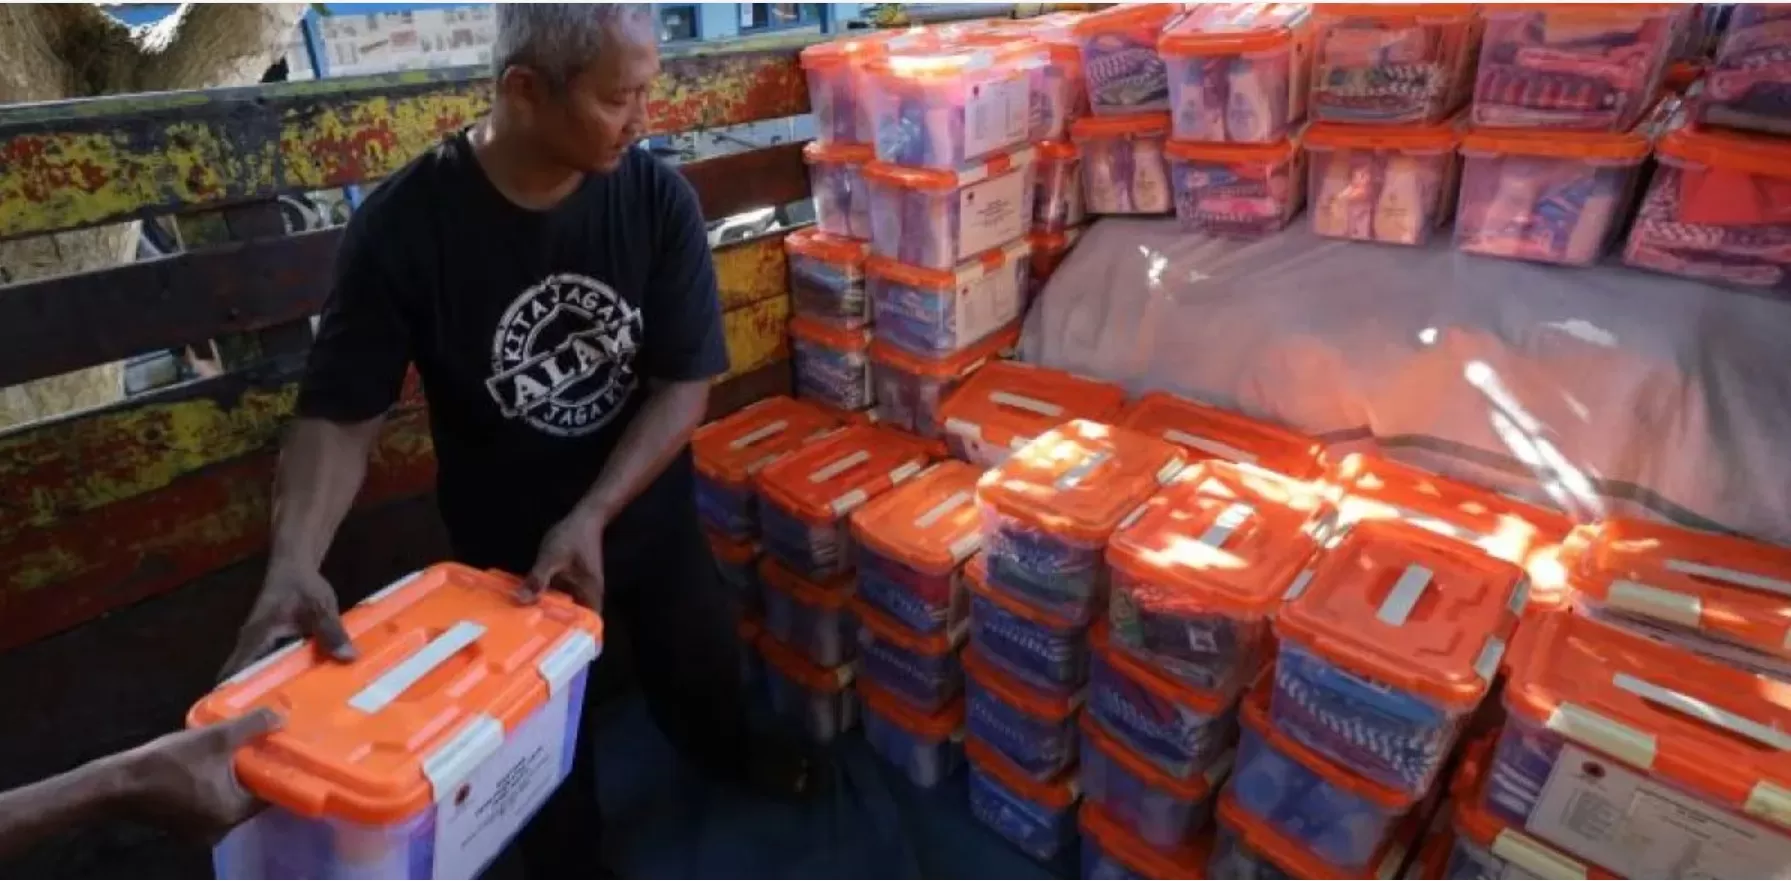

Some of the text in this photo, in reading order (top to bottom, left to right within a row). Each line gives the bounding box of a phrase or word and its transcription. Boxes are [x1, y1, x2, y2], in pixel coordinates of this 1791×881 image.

[504, 284, 614, 361] KITA JAGA
[513, 324, 637, 408] ALAM
[543, 402, 601, 426] JAGA
